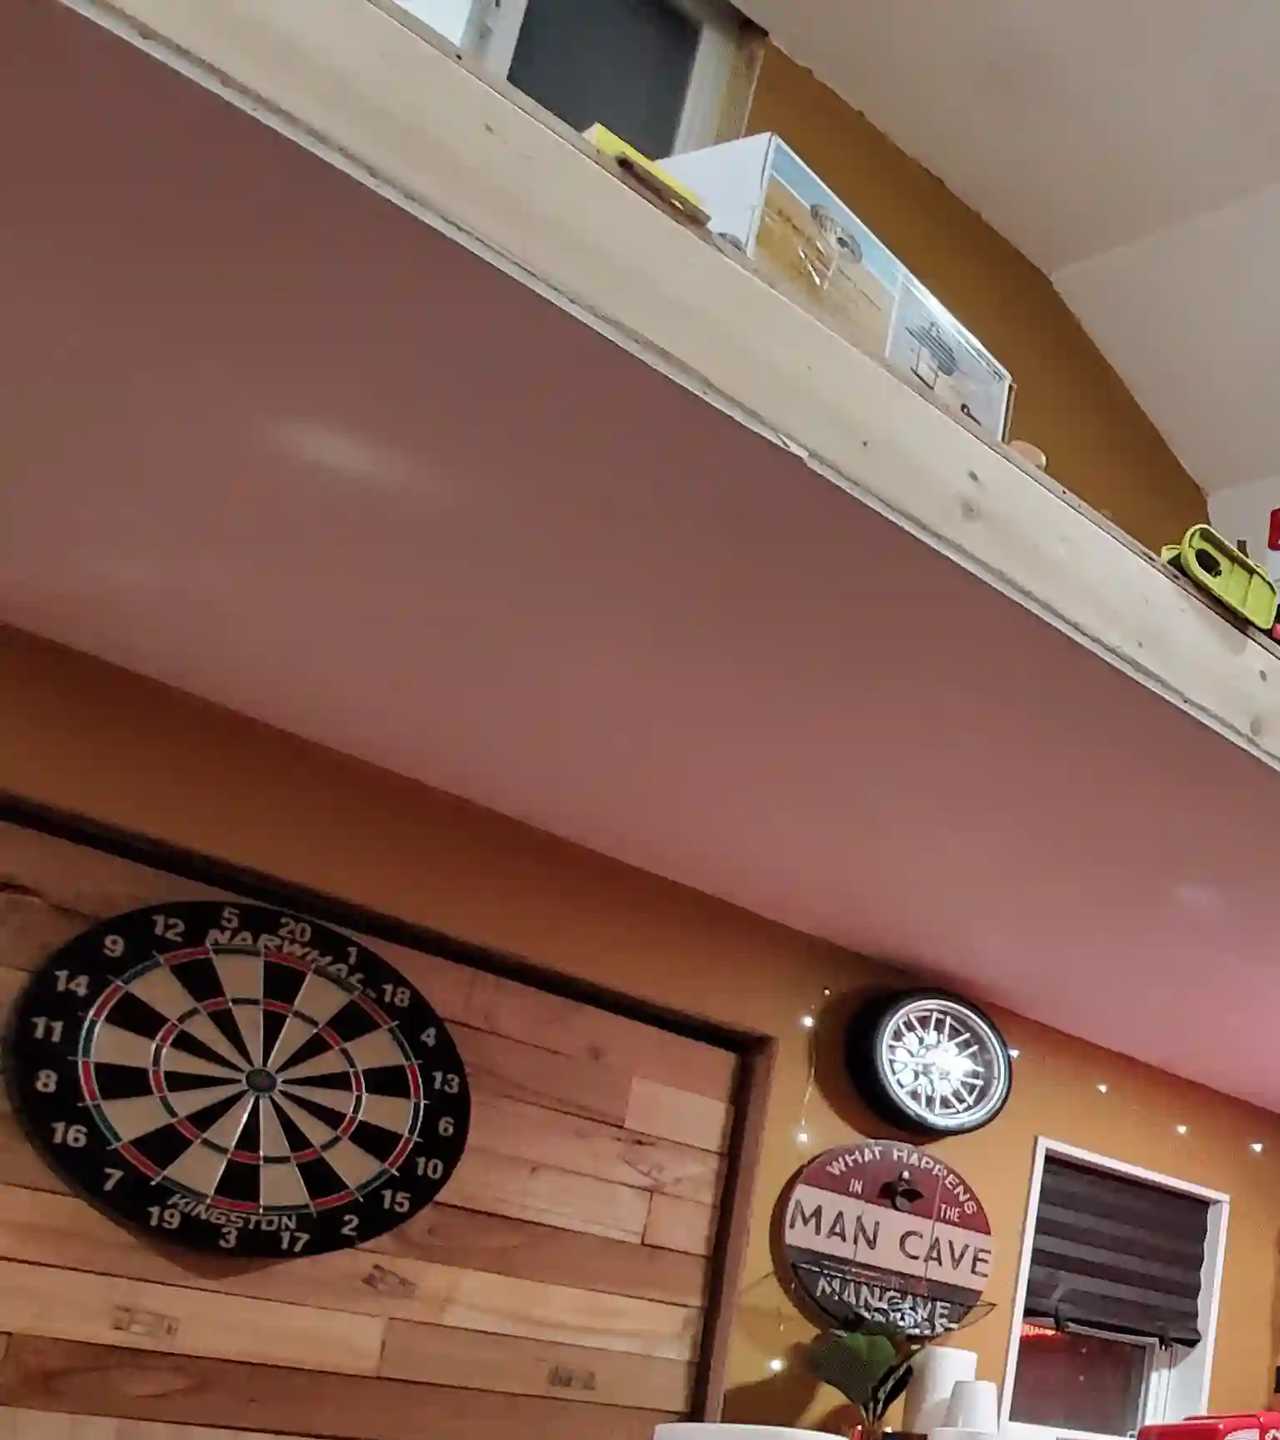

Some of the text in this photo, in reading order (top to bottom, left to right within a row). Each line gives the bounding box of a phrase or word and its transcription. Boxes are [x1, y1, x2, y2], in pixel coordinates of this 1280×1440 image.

[151, 914, 186, 942] 12
[221, 907, 238, 928] 5
[279, 917, 311, 941] 20
[104, 935, 125, 958] 9
[347, 947, 358, 963] 1
[206, 928, 364, 994] NARWHAL
[54, 970, 90, 997] 14
[381, 983, 411, 1007] 18
[31, 1016, 63, 1043] 11
[420, 1028, 437, 1047] 4
[34, 1069, 58, 1092] 8
[432, 1071, 460, 1092] 13
[51, 1121, 87, 1147] 16
[438, 1117, 454, 1137] 6
[103, 1168, 125, 1190] 7
[415, 1156, 444, 1179] 10
[826, 1146, 978, 1215] WHAT HAPPENS
[381, 1189, 411, 1212] 15
[849, 1178, 962, 1223] IN THE
[148, 1206, 182, 1229] 19
[166, 1193, 298, 1232] KINGSTON
[219, 1227, 238, 1248] 3
[341, 1215, 359, 1237] 2
[280, 1231, 310, 1252] 17
[789, 1199, 992, 1278] MAN CAVE
